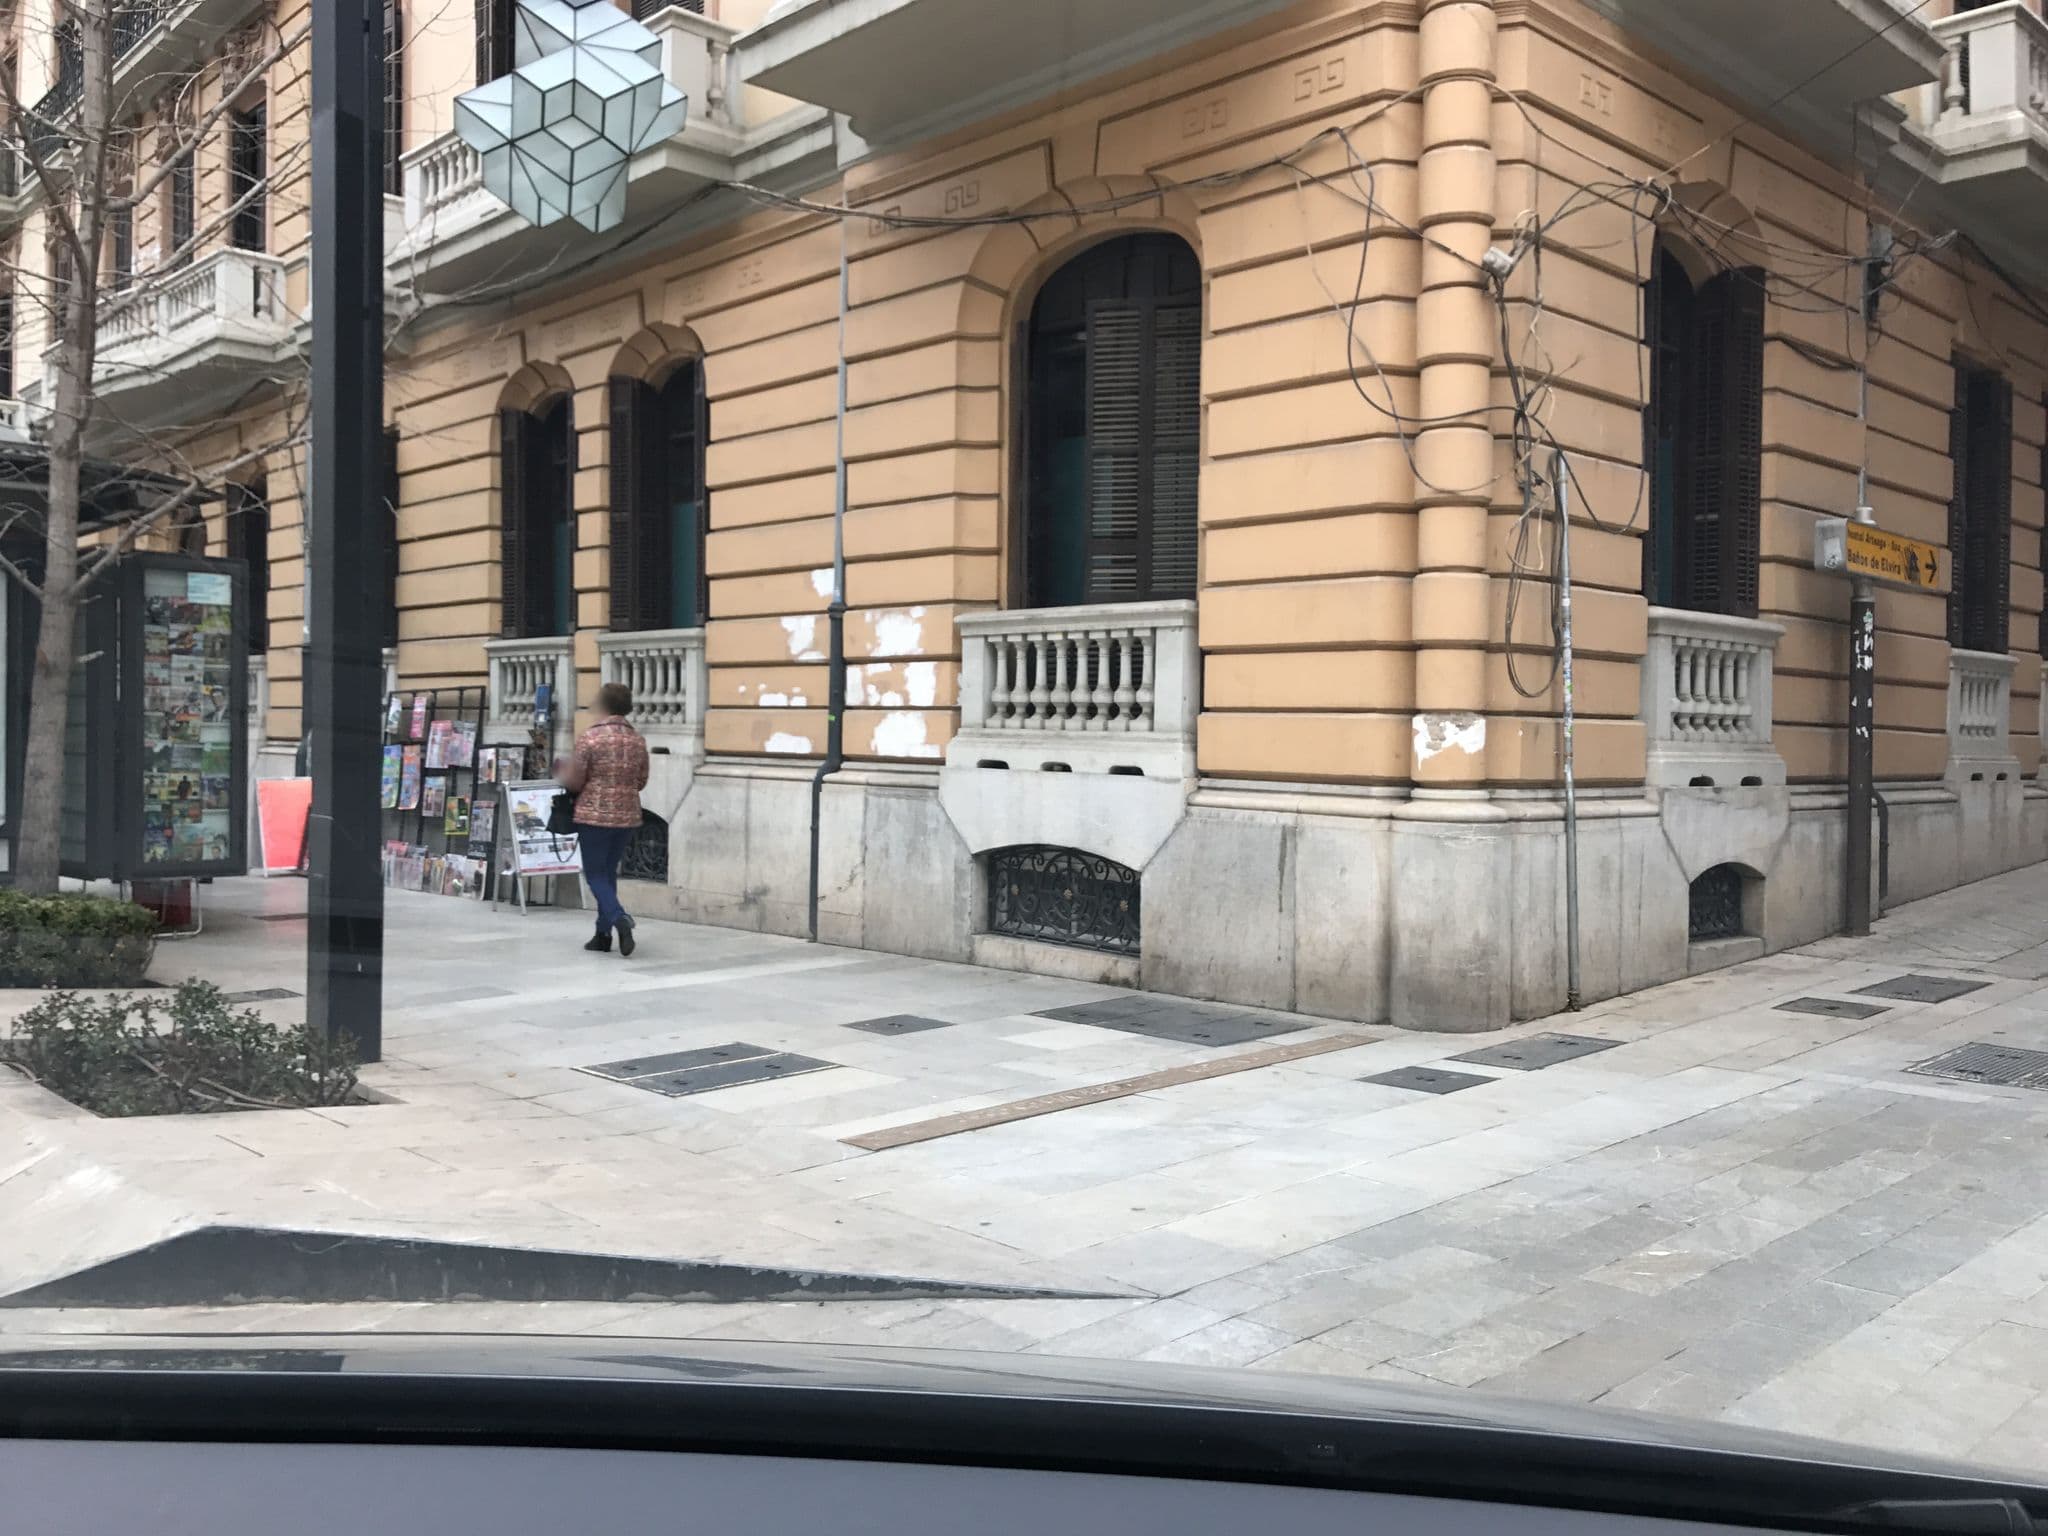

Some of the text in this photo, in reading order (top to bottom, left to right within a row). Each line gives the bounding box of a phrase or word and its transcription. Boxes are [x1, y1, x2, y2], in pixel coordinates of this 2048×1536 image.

[1848, 549, 1901, 575] Baños de Elvira
